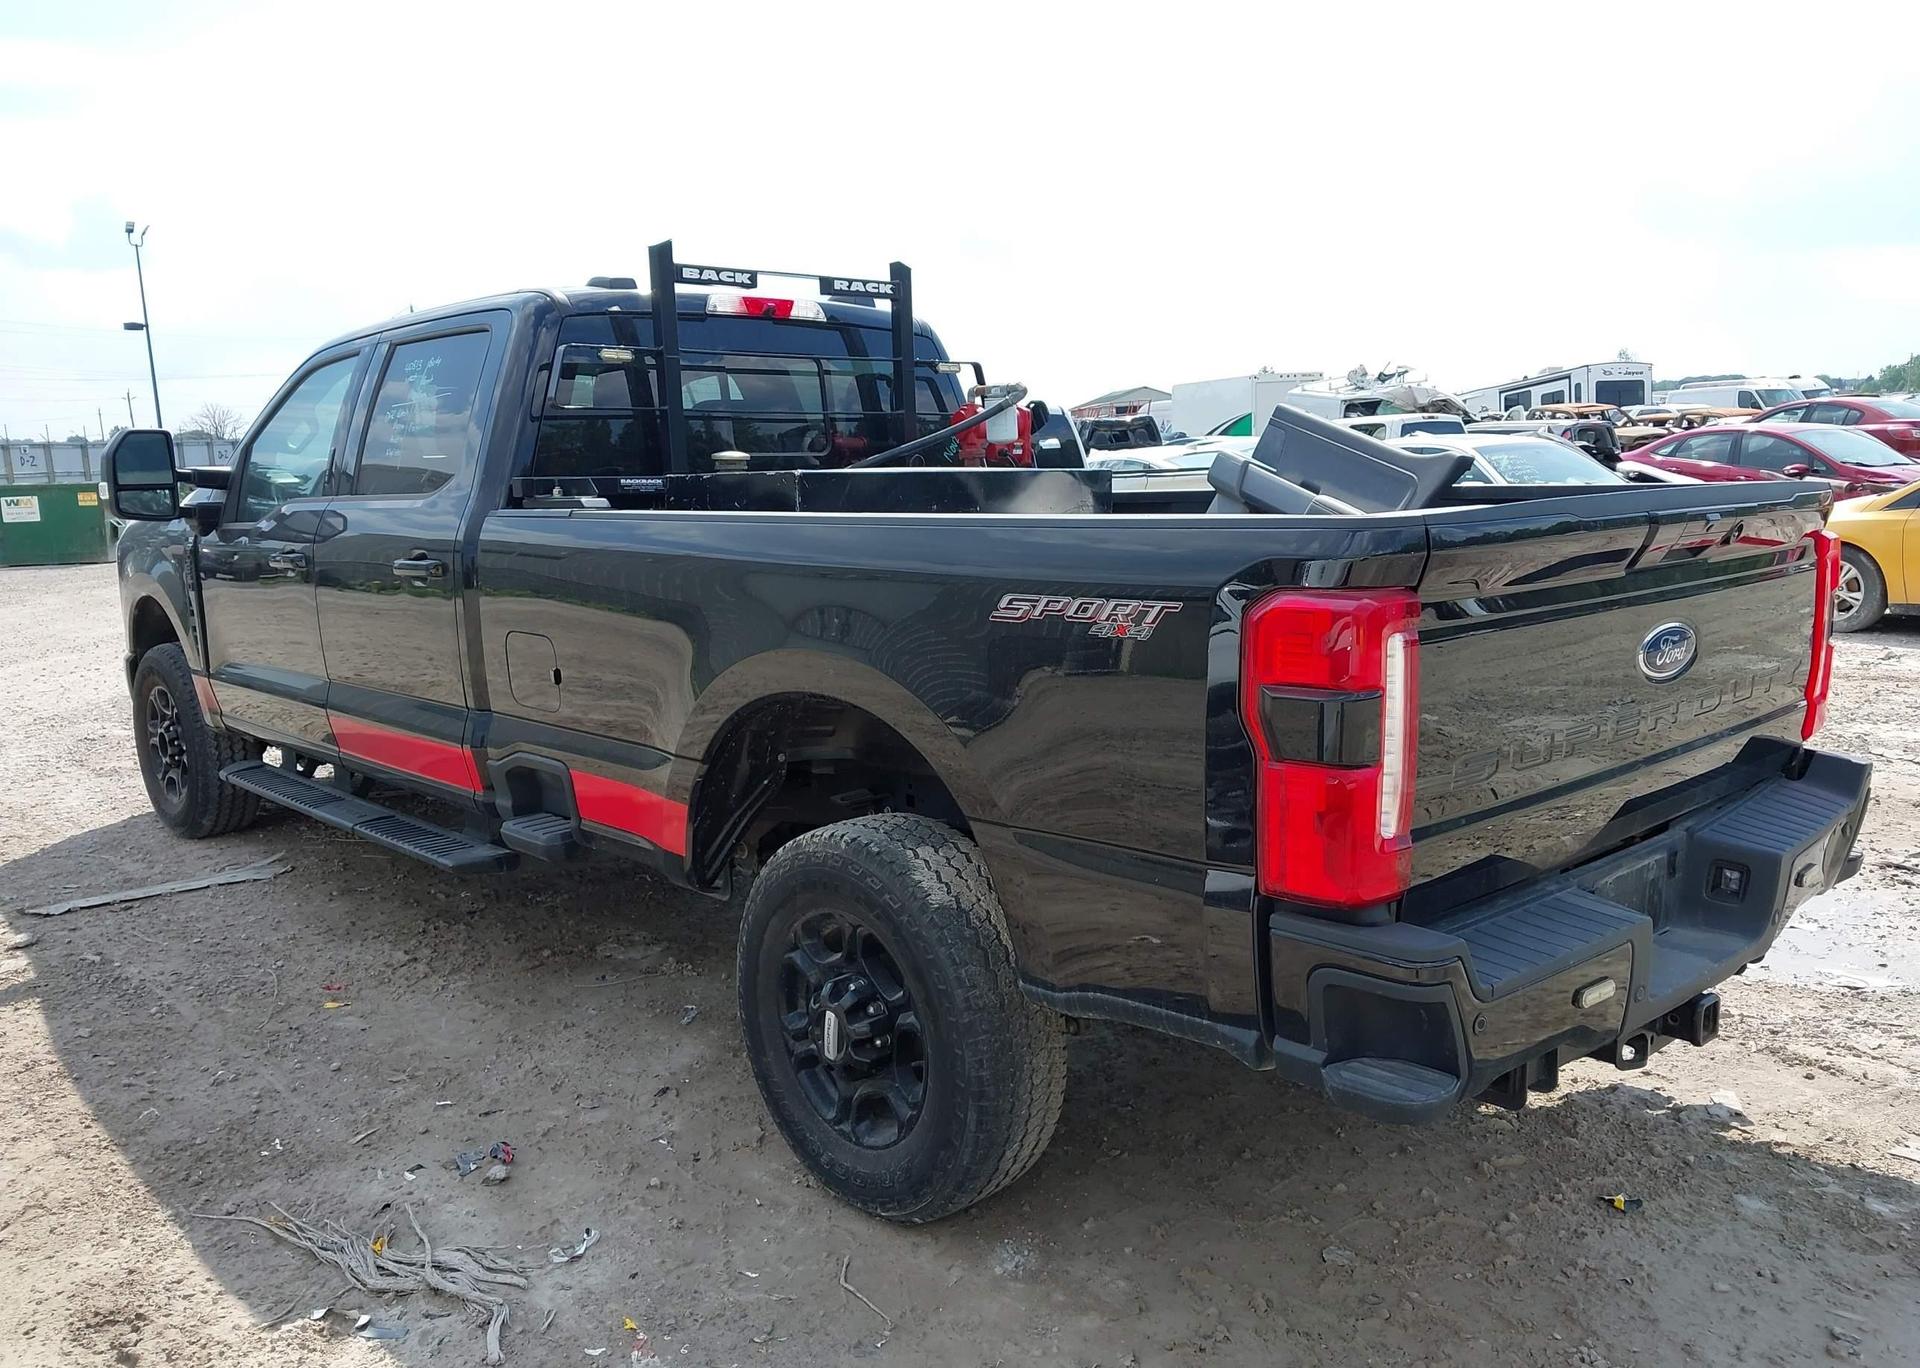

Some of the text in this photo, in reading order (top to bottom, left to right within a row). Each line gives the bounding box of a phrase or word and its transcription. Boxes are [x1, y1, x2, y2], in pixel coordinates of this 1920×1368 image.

[682, 267, 895, 294] BACK RACK
[989, 593, 1184, 627] SPORT
[1656, 635, 1687, 666] Ford
[1452, 700, 1681, 790] SUPER
